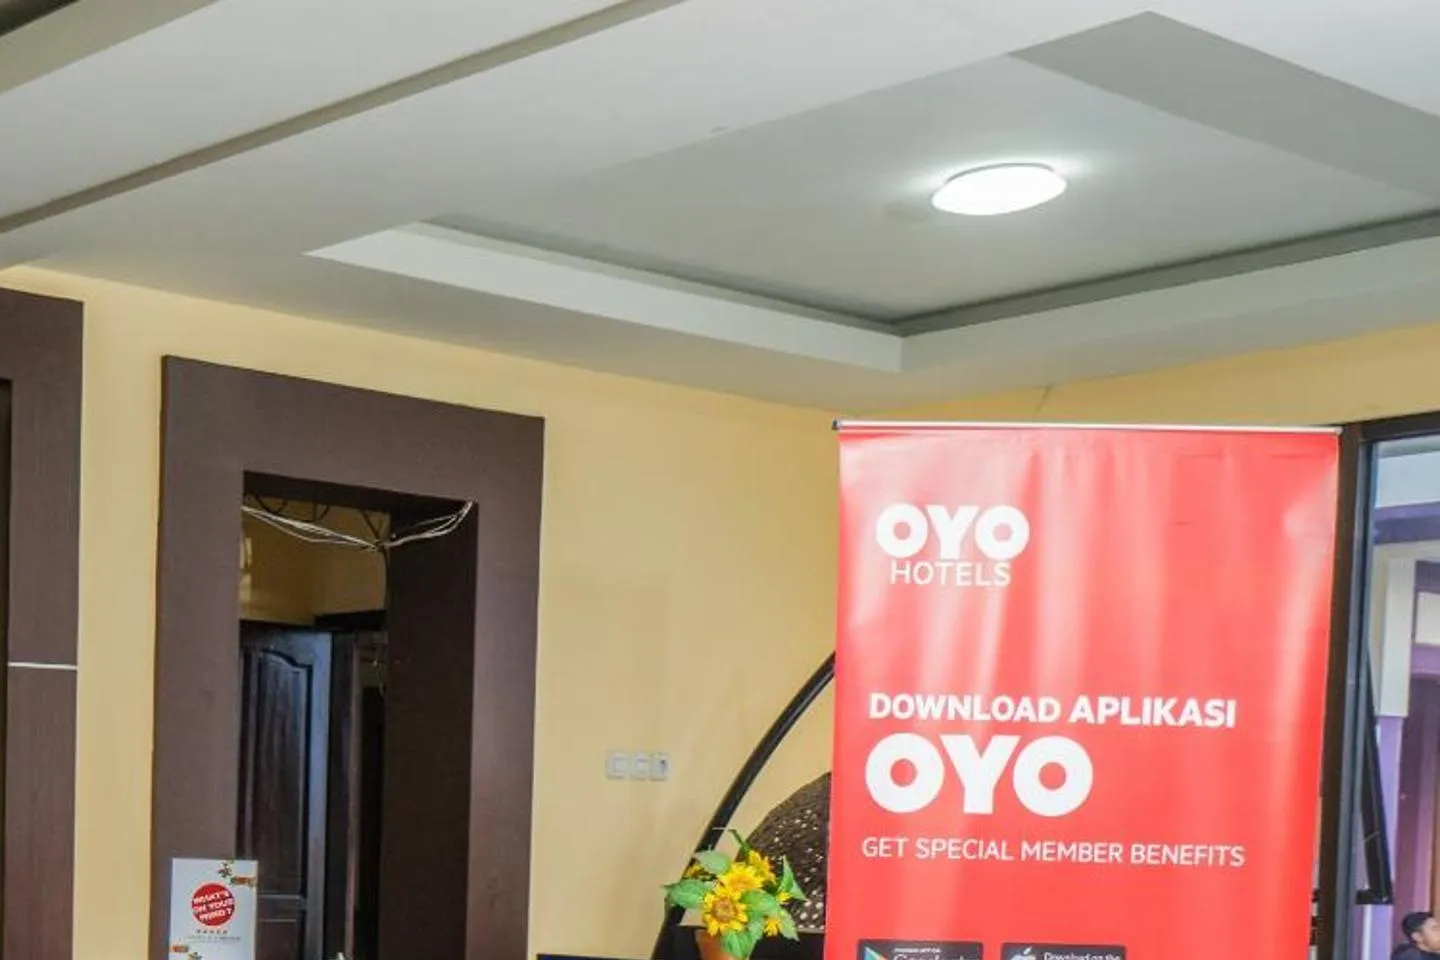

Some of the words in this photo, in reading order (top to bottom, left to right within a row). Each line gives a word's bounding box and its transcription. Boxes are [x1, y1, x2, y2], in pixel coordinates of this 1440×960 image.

[875, 503, 1030, 560] OYO
[889, 560, 1012, 588] HOTELS
[868, 693, 1061, 723] DOWNLOAD
[1068, 695, 1237, 728] APLIKASI
[864, 732, 1094, 817] OYO
[862, 836, 909, 859] GET
[914, 838, 1014, 862] SPECIAL
[1020, 840, 1124, 864] MEMBER
[1129, 843, 1246, 868] BENEFITS
